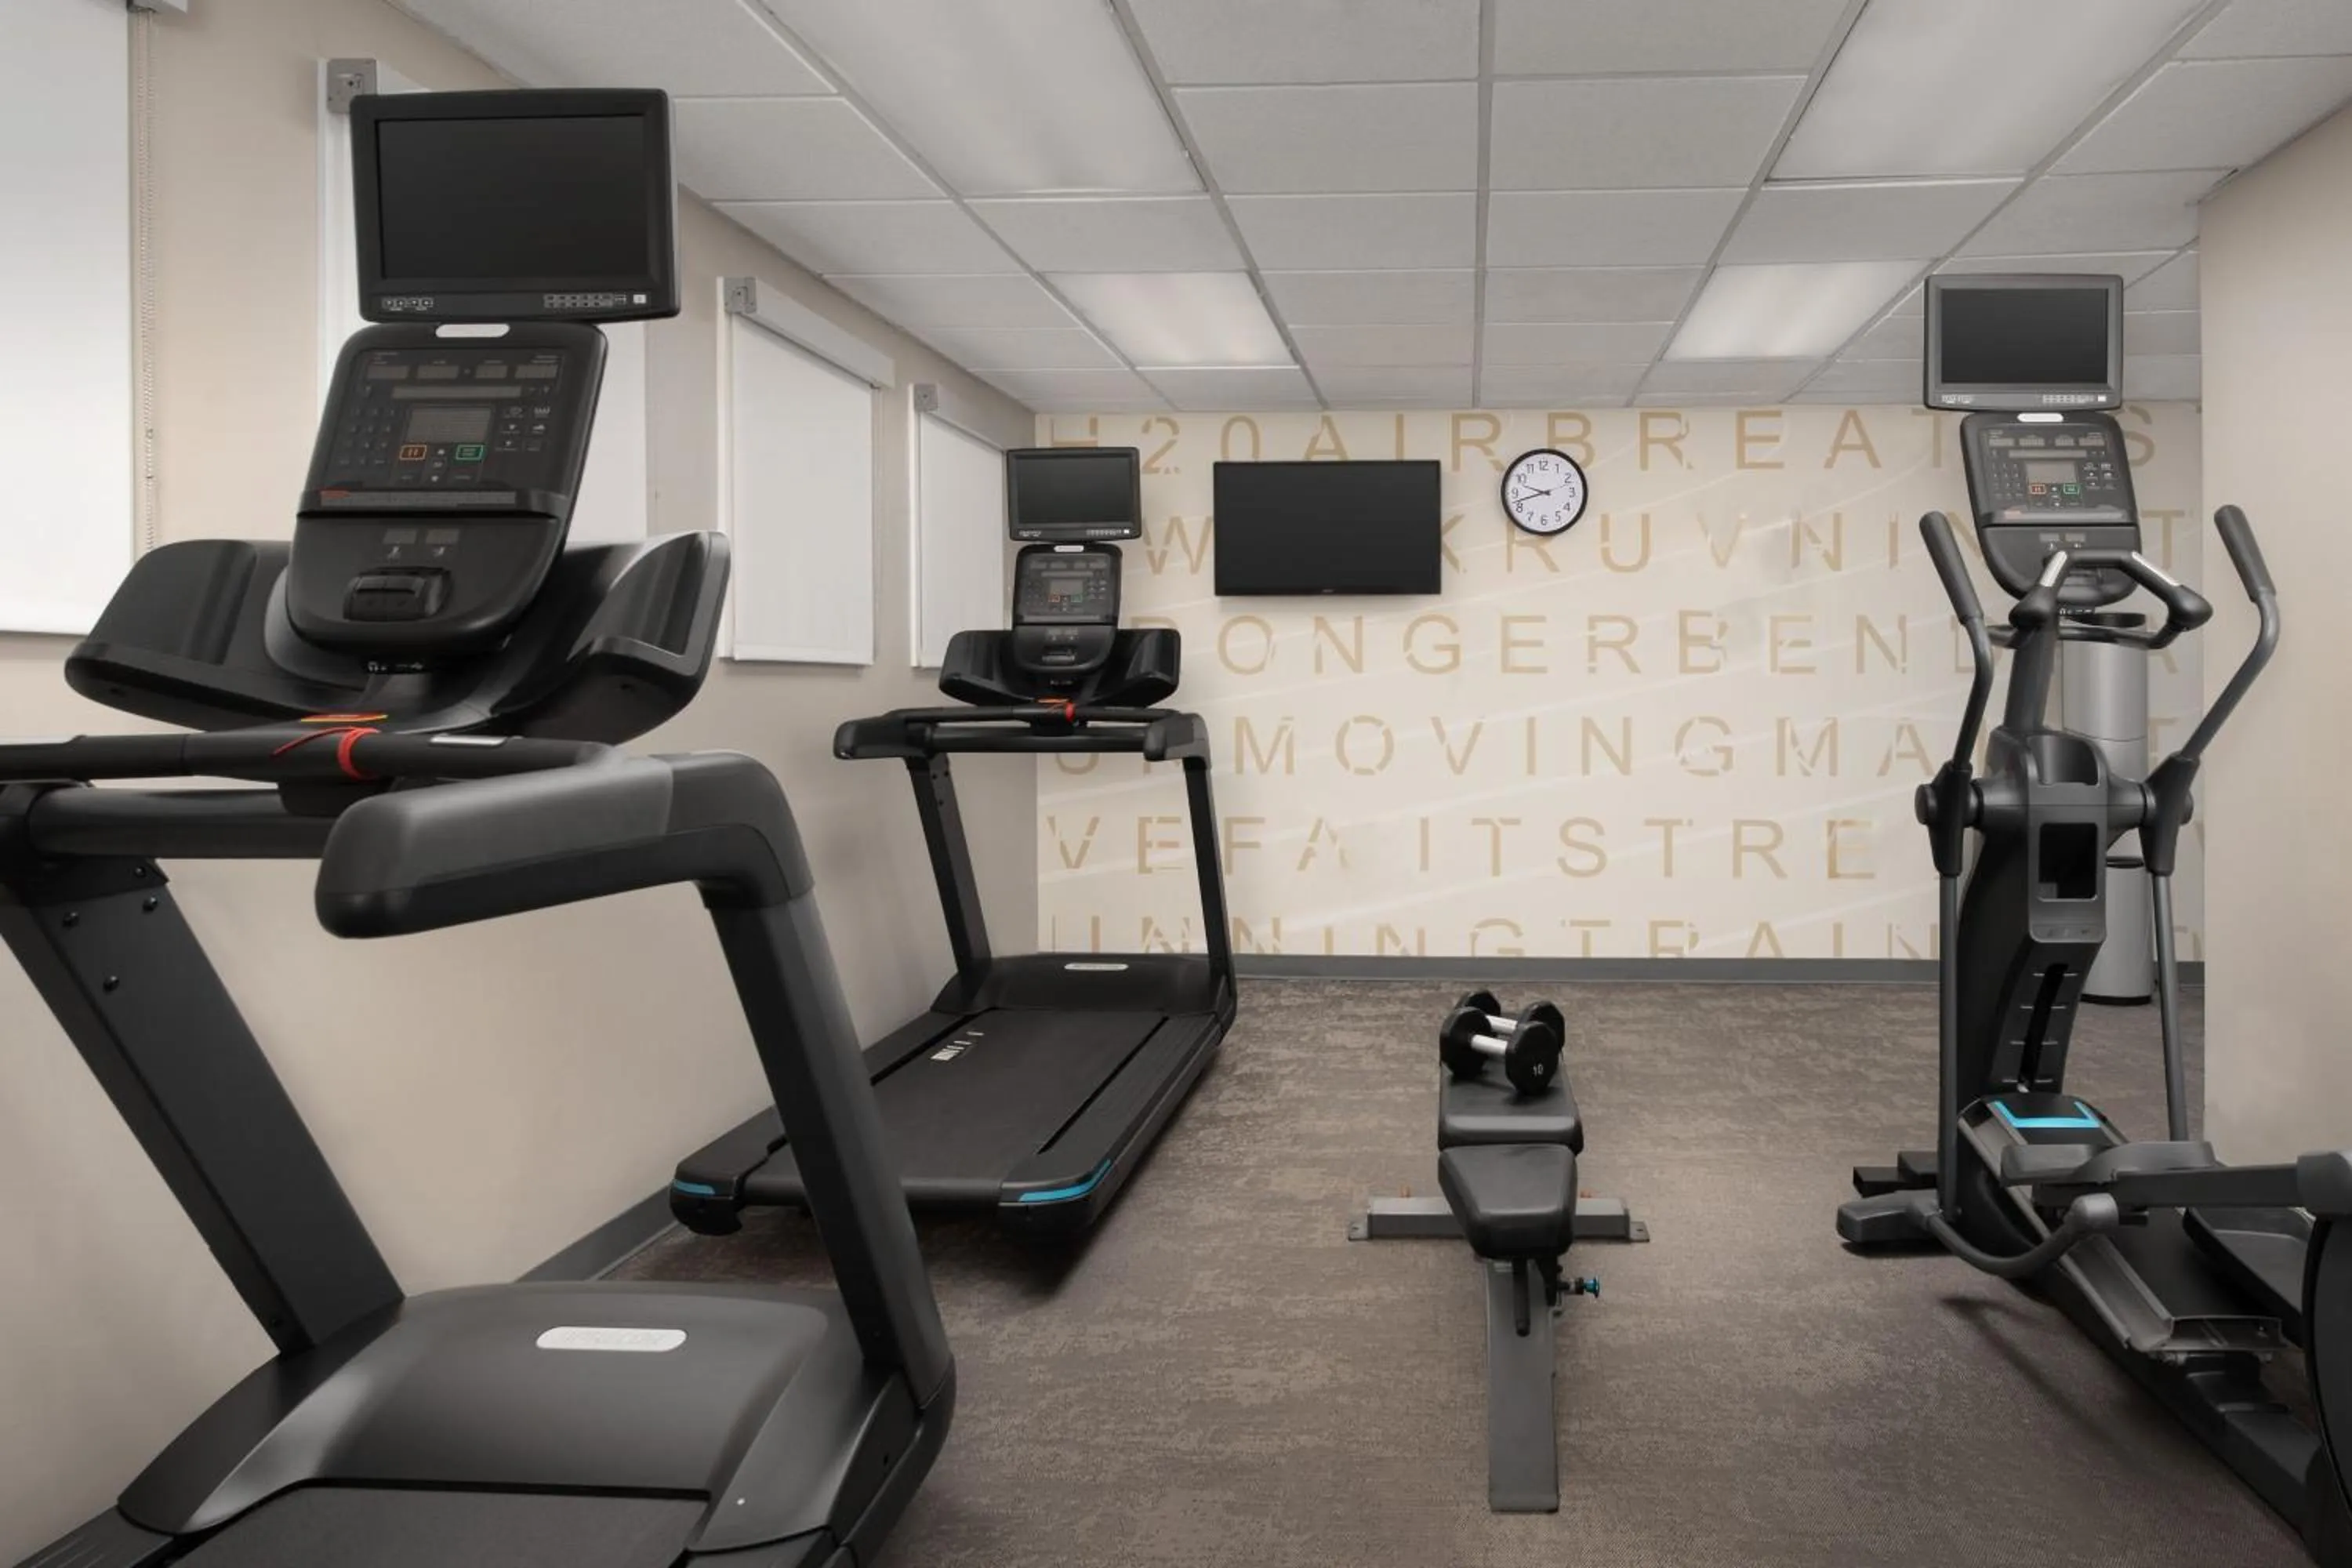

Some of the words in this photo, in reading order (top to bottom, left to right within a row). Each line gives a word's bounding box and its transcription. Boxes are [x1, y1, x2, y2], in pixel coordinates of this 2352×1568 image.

[1526, 463, 1534, 474] 11
[1538, 460, 1549, 471] 12
[1555, 463, 1559, 474] 1
[1516, 473, 1527, 484] 10
[1564, 473, 1573, 484] 2
[1512, 488, 1519, 499] 9
[1569, 487, 1576, 498] 3
[1515, 503, 1523, 513] 8
[1563, 502, 1570, 511] 4
[1527, 511, 1534, 521] 7
[1541, 514, 1548, 525] 6
[1555, 511, 1561, 522] 5
